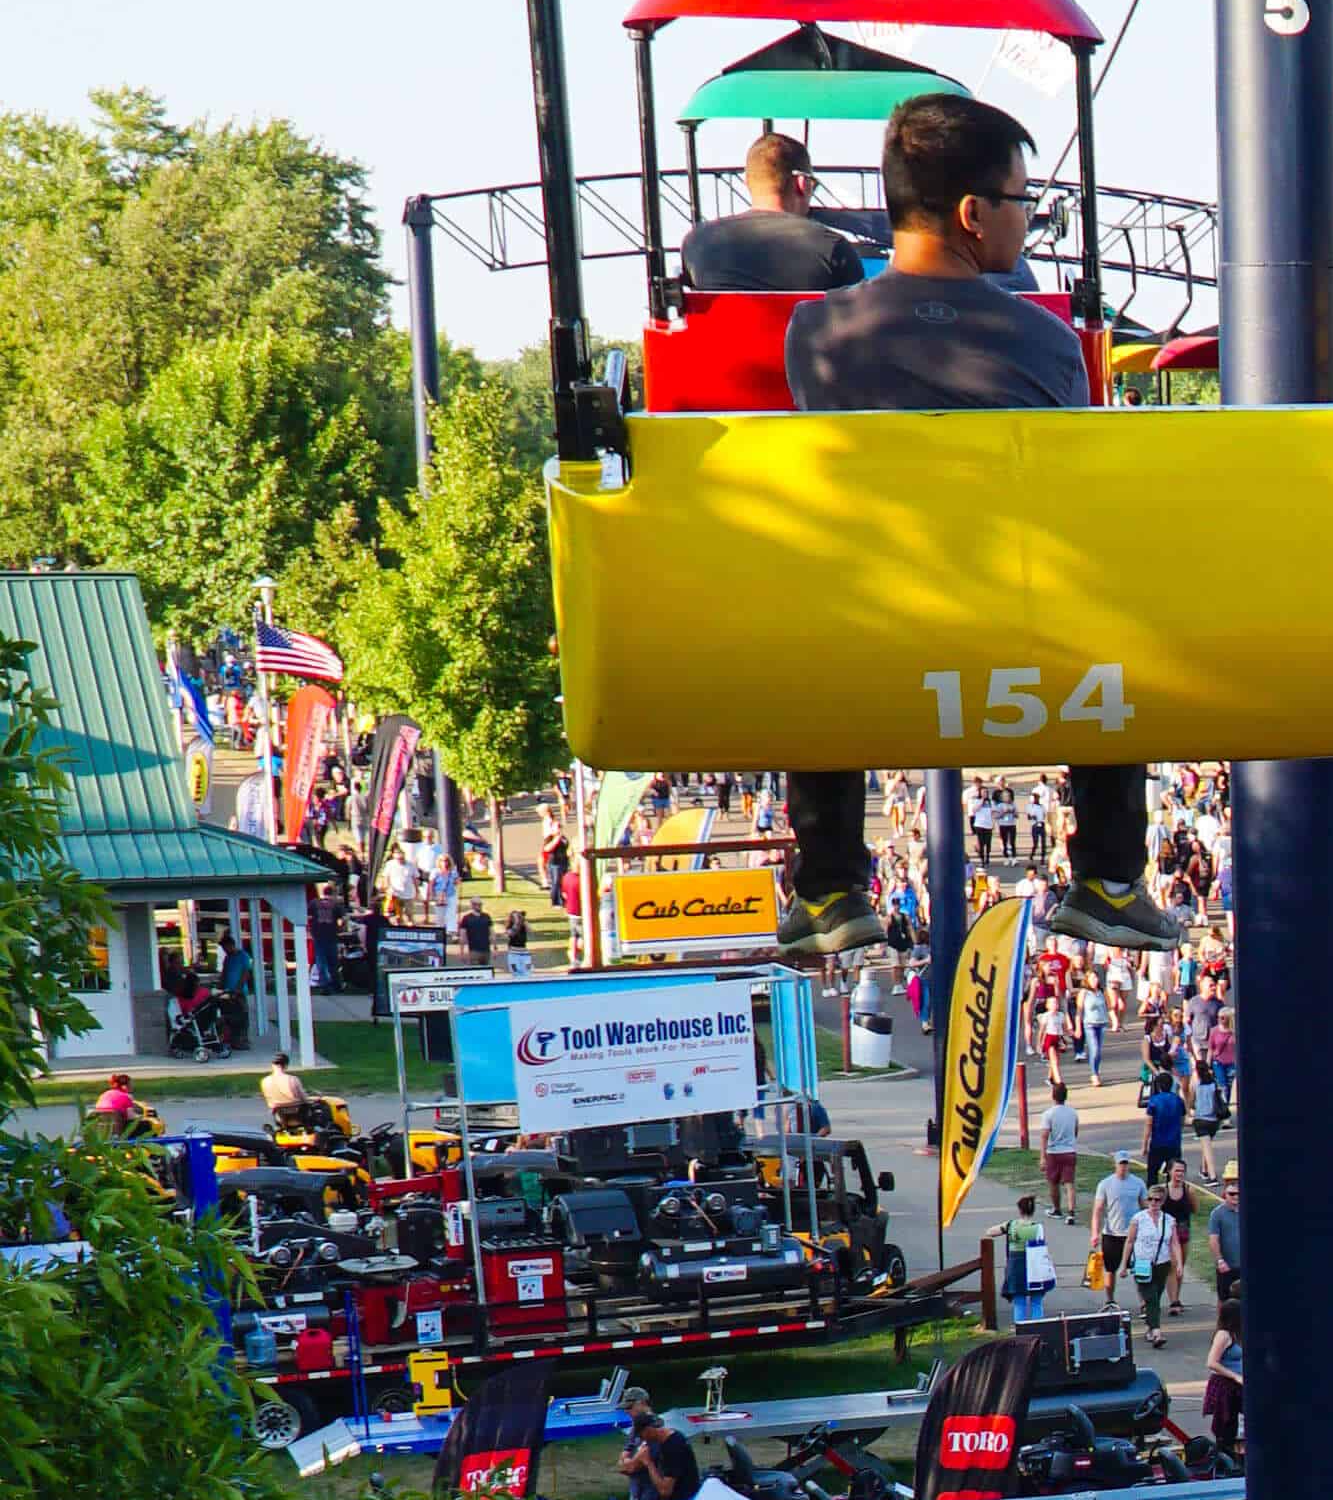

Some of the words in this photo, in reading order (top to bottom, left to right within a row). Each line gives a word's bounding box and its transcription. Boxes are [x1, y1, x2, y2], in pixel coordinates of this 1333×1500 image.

[922, 662, 1136, 739] 154
[632, 899, 680, 920] Cub
[683, 896, 763, 917] Cadet
[560, 1023, 602, 1051] Tool
[605, 1015, 713, 1046] Warehouse
[717, 1011, 751, 1036] Inc.
[959, 949, 997, 1101] Cadet
[951, 1101, 984, 1181] Cub
[947, 1431, 1009, 1453] TORO
